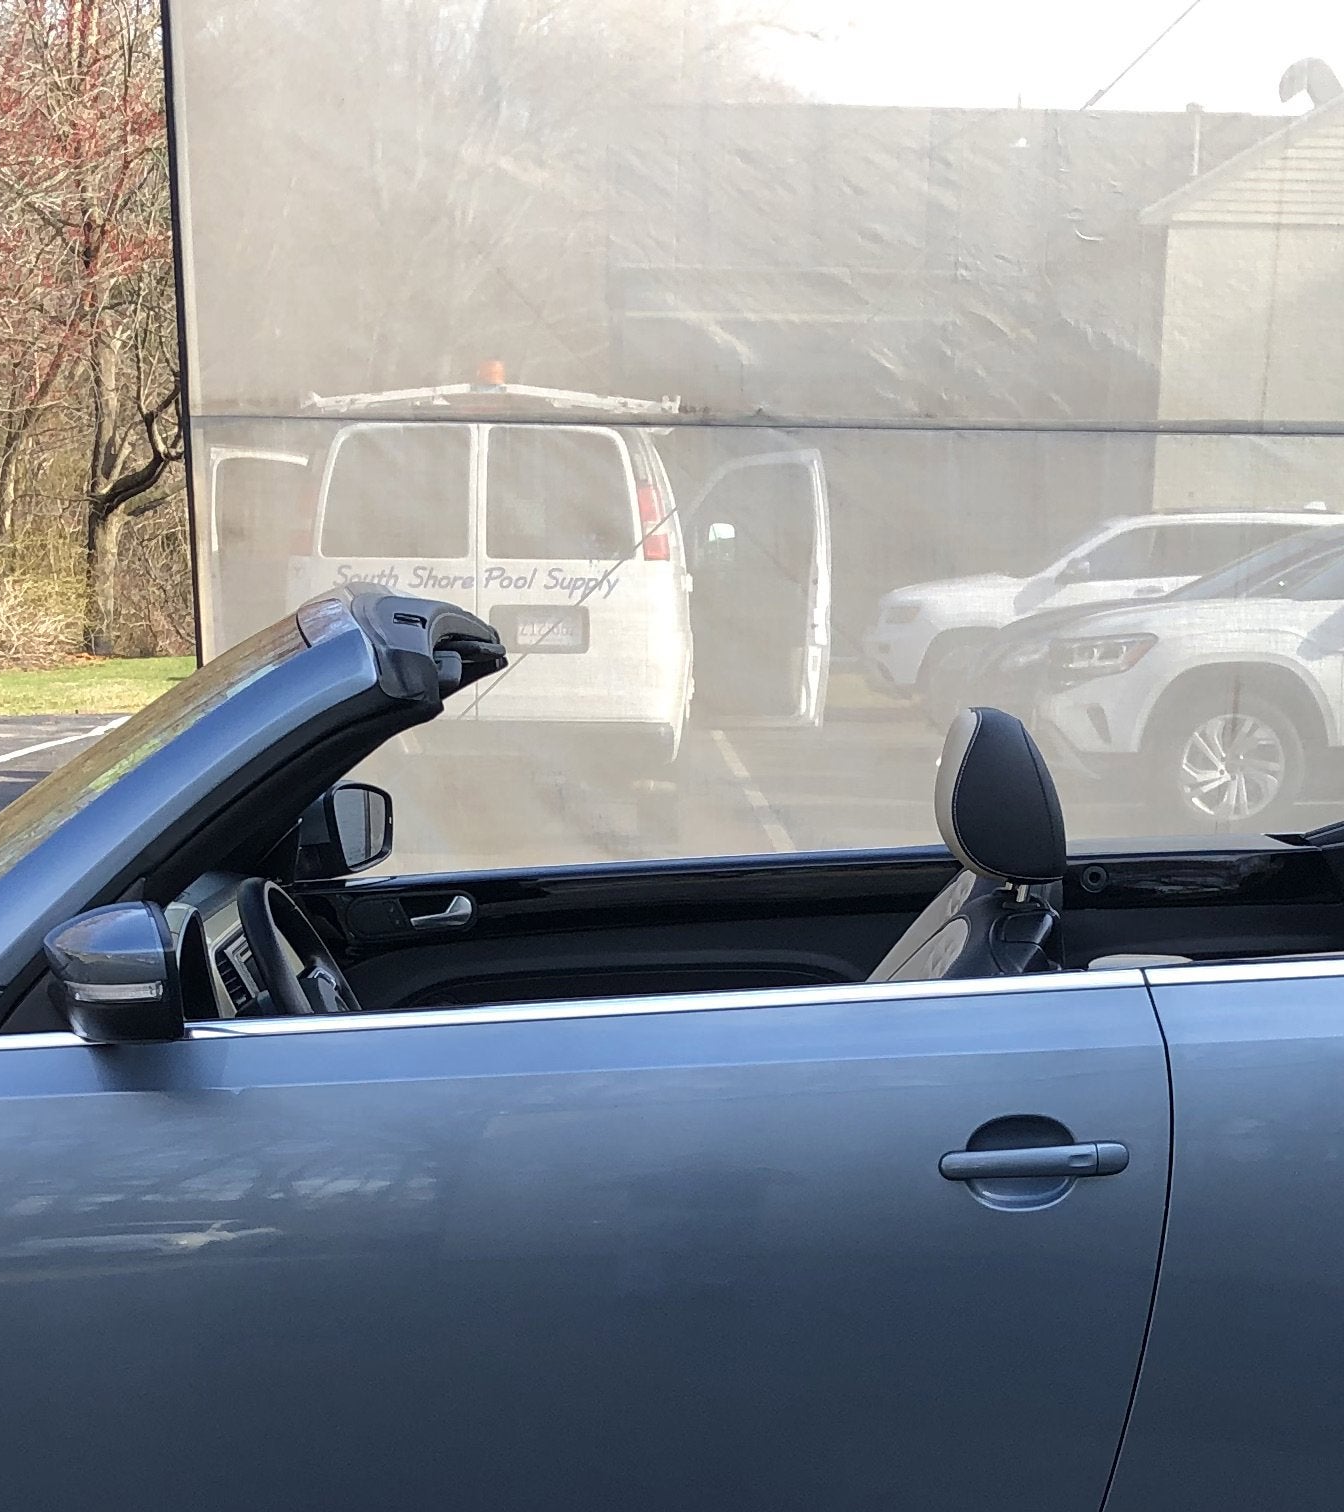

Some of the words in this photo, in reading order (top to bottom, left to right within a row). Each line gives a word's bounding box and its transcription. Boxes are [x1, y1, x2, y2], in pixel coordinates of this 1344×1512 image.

[333, 565, 399, 587] South
[408, 566, 475, 590] Shore
[484, 567, 538, 590] Pool
[543, 568, 619, 599] Supply
